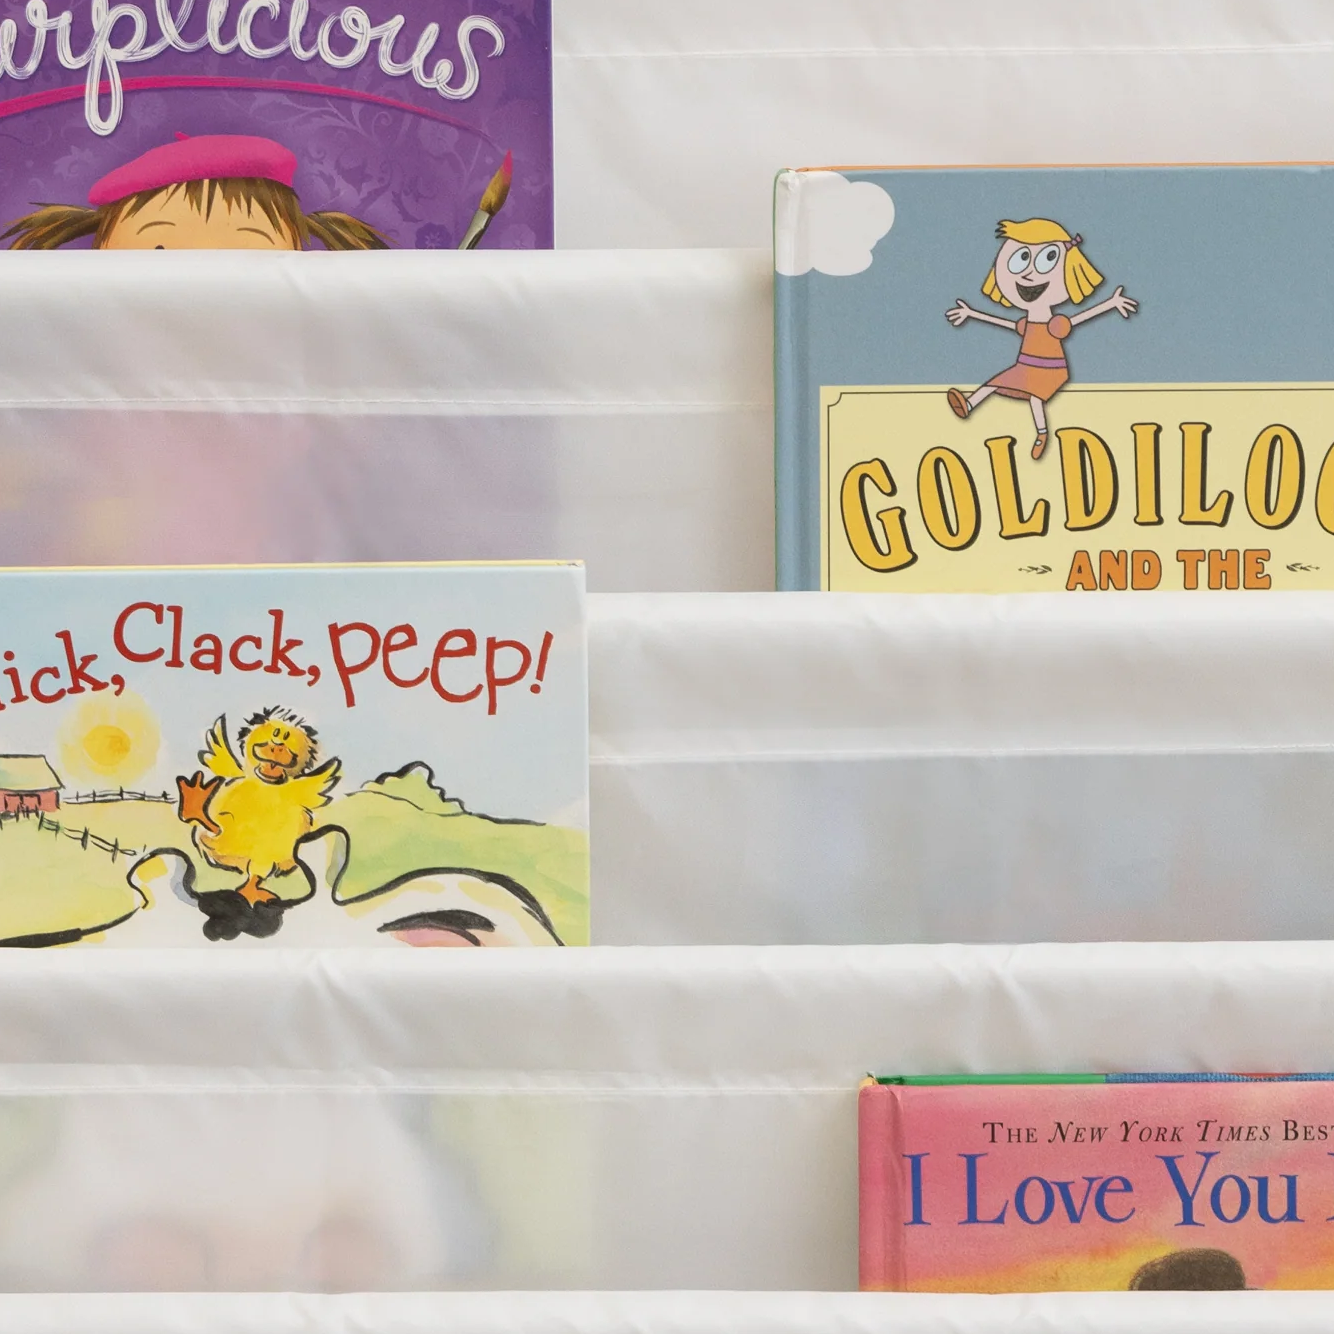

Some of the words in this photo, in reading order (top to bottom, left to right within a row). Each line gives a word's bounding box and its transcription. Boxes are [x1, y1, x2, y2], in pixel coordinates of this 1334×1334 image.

[1065, 549, 1162, 591] AND
[1176, 548, 1272, 590] THE
[113, 601, 321, 685] Clack,
[902, 1151, 931, 1227] I
[957, 1152, 1136, 1226] Love
[1155, 1150, 1306, 1228] You
